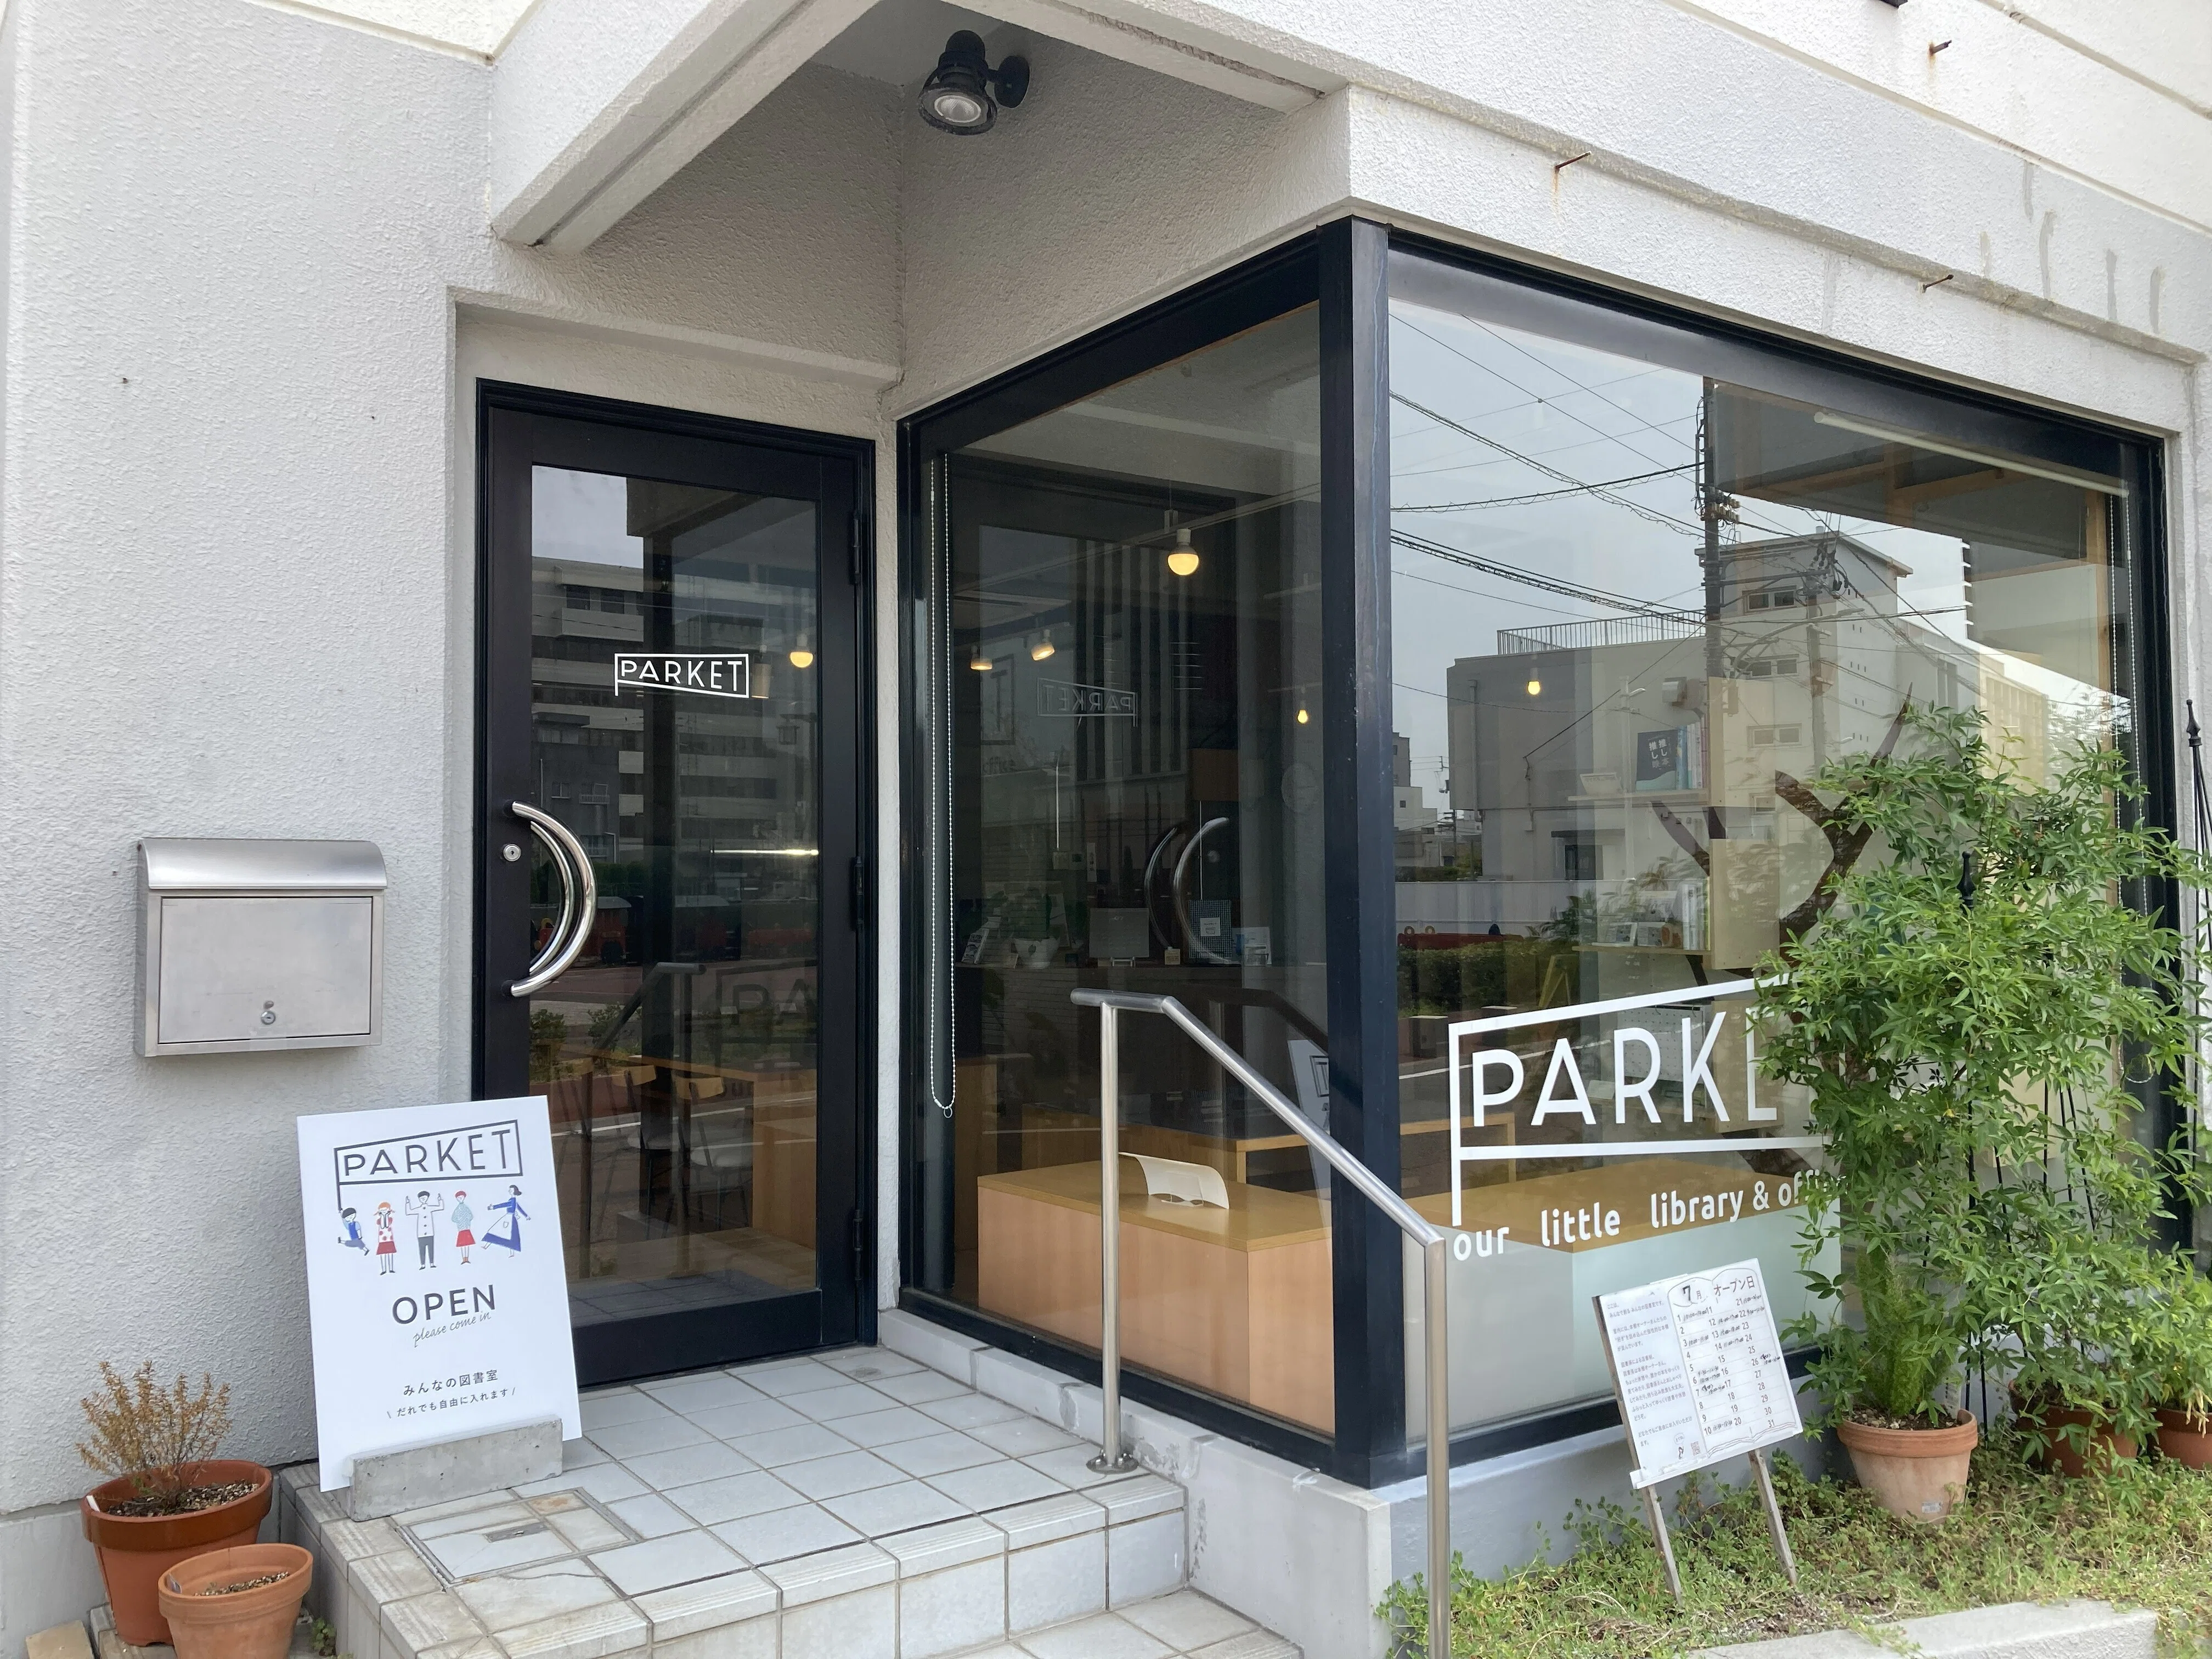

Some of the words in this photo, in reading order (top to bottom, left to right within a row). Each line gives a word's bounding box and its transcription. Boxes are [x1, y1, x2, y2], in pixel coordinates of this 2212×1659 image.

[620, 660, 742, 691] PARKET
[1472, 1006, 1817, 1127] PARKE
[343, 1128, 514, 1177] PARKET
[1453, 1224, 1510, 1261] our
[1541, 1202, 1620, 1247] little
[1651, 1190, 1744, 1228] library
[1753, 1181, 1770, 1211] &
[1713, 1276, 1755, 1297] オープン日
[392, 1284, 495, 1325] OPEN
[1736, 1297, 1743, 1306] 21
[413, 1325, 447, 1348] please
[449, 1316, 477, 1331] come
[479, 1311, 492, 1322] in
[1742, 1322, 1749, 1330] 23
[1712, 1330, 1719, 1339] 13
[1745, 1334, 1752, 1342] 24
[1715, 1342, 1722, 1351] 14
[1748, 1346, 1755, 1354] 25
[1718, 1355, 1725, 1363] 15
[1751, 1358, 1758, 1366] 26
[1721, 1367, 1729, 1375] 16
[1754, 1370, 1761, 1378] 27
[403, 1369, 499, 1397] みんなの図書室
[1724, 1379, 1731, 1387] 17
[1758, 1382, 1765, 1391] 28
[1728, 1392, 1735, 1401] 18
[1761, 1395, 1768, 1403] 29
[397, 1388, 509, 1418] だれでも自由に入れます
[1731, 1404, 1738, 1414] 19
[1764, 1407, 1771, 1415] 30
[1734, 1417, 1742, 1426] 20
[1768, 1419, 1776, 1429] 31
[1705, 1426, 1712, 1436] 10
